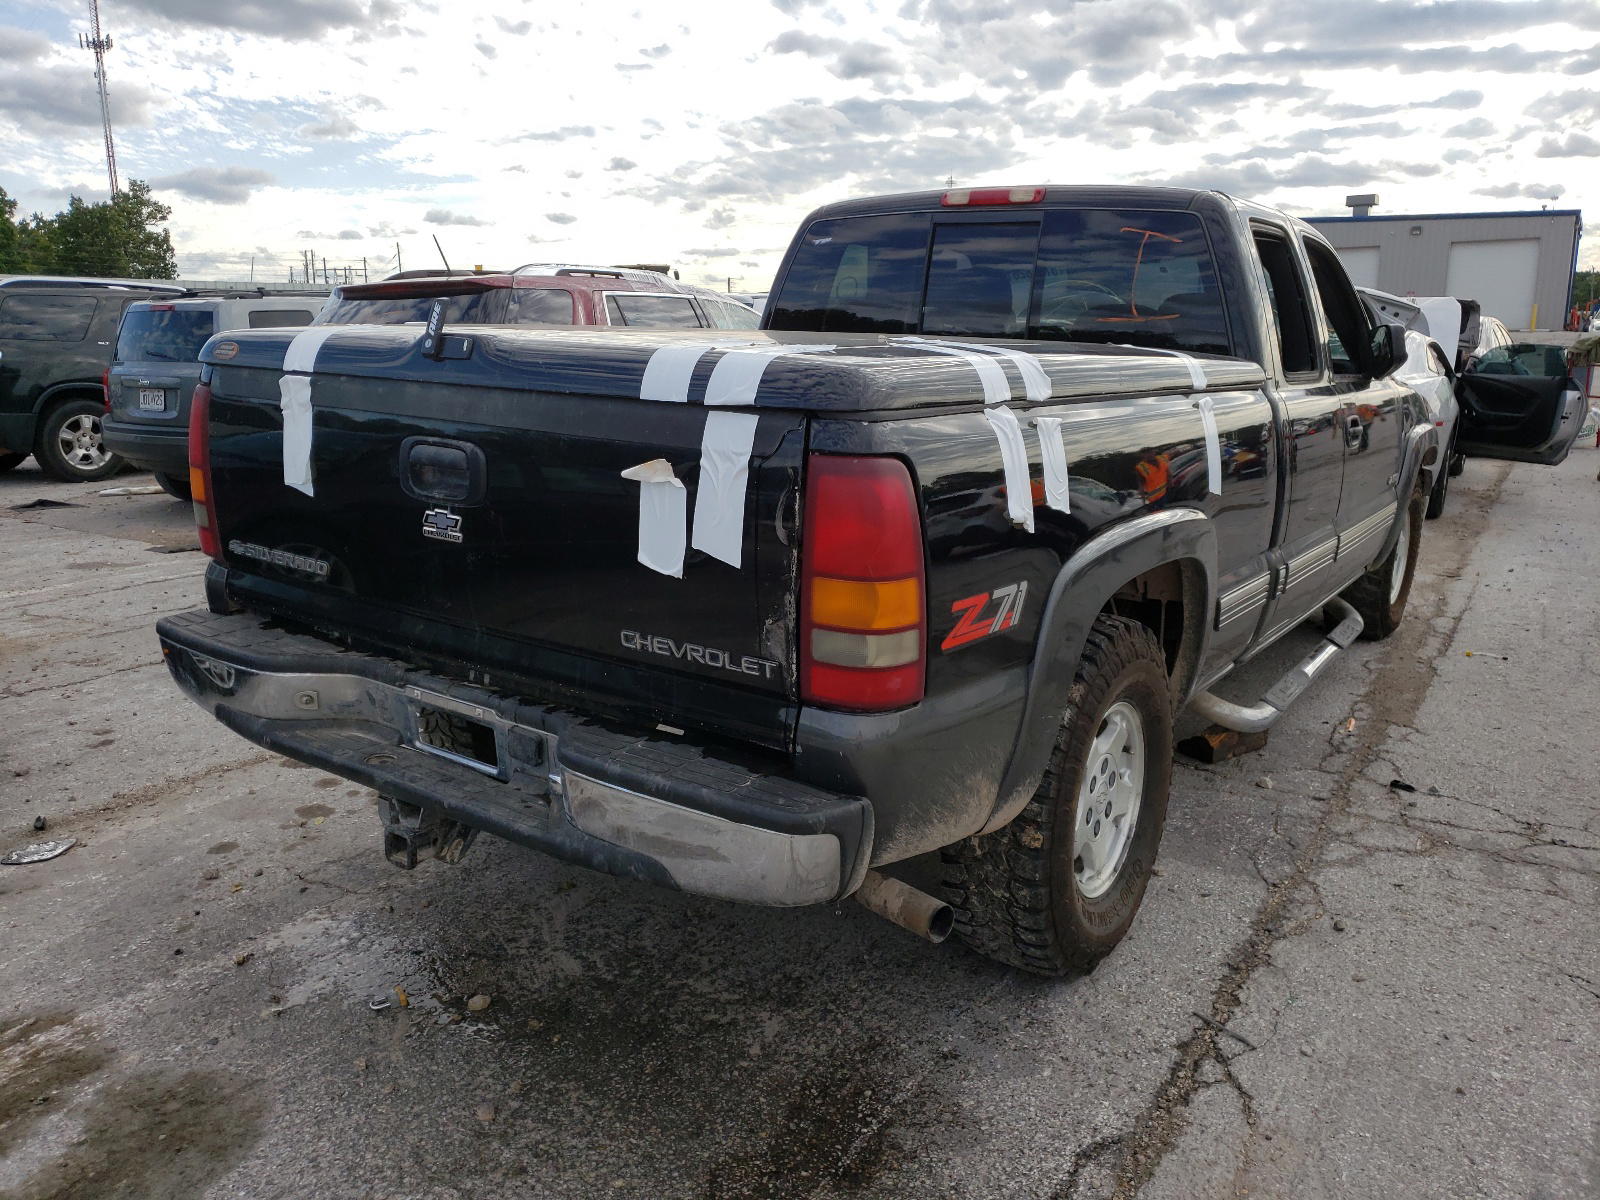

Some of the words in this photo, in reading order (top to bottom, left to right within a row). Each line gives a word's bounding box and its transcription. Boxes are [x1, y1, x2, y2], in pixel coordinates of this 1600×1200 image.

[244, 542, 330, 577] SILVERADO
[941, 580, 1028, 652] Z71
[620, 629, 780, 679] CHEVROLET
